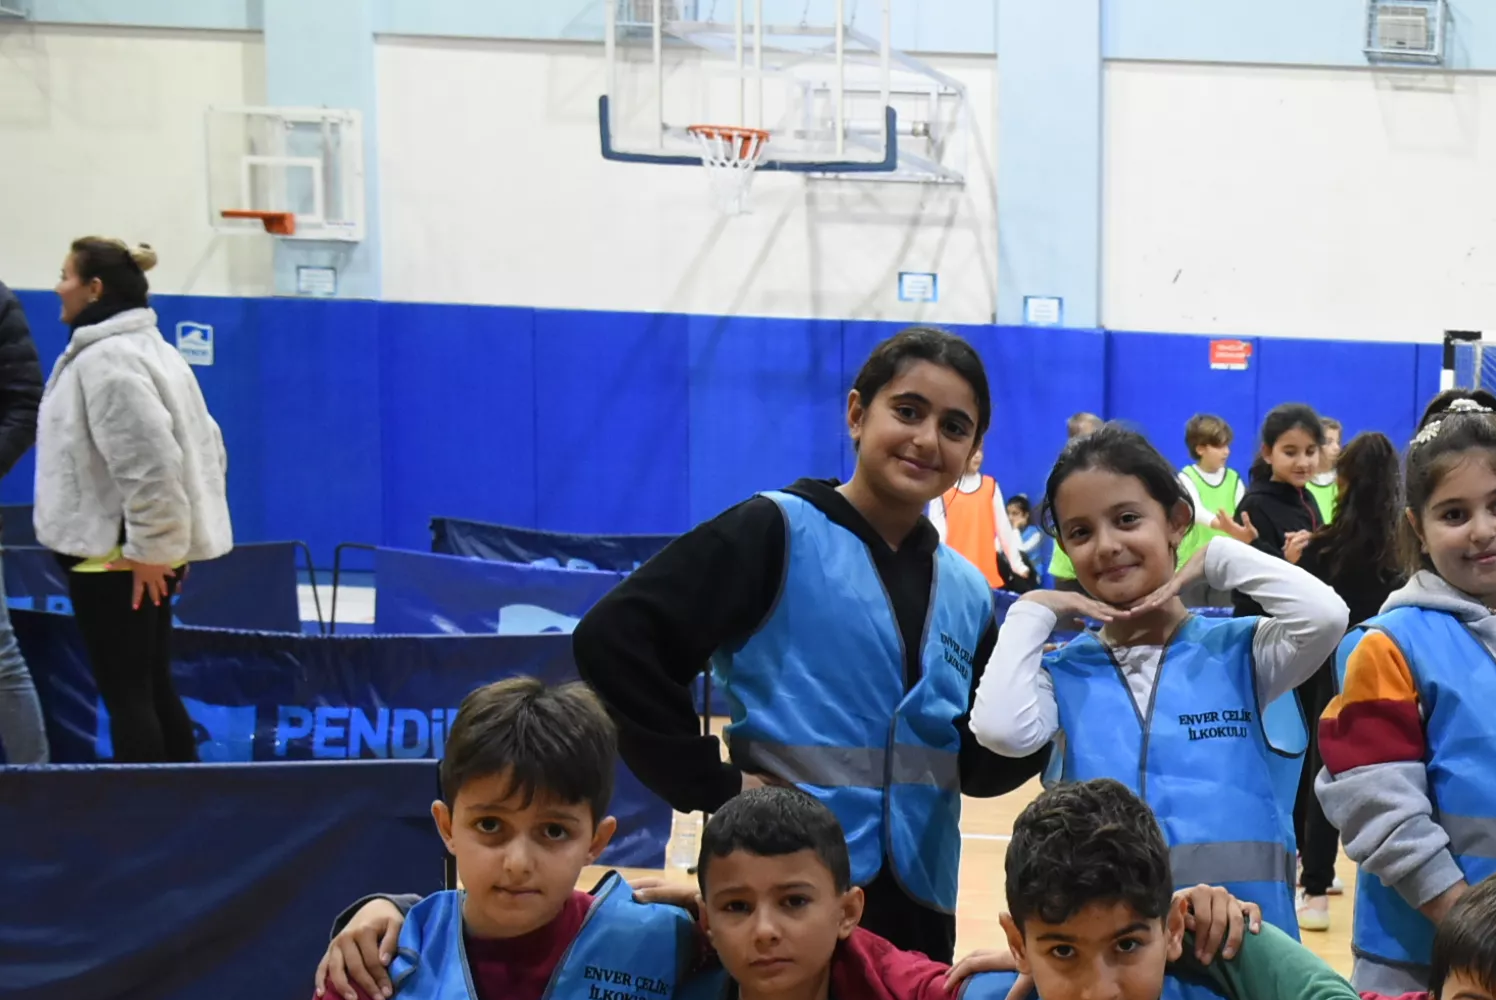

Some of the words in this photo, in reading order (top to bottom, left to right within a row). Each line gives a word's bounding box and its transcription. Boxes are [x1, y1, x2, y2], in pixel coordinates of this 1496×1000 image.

[1179, 711, 1220, 726] ENVER
[1222, 708, 1252, 723] ÇELİK
[1188, 726, 1247, 741] İLKOKULU
[584, 966, 631, 986] ENVER
[635, 975, 668, 995] ÇELİK
